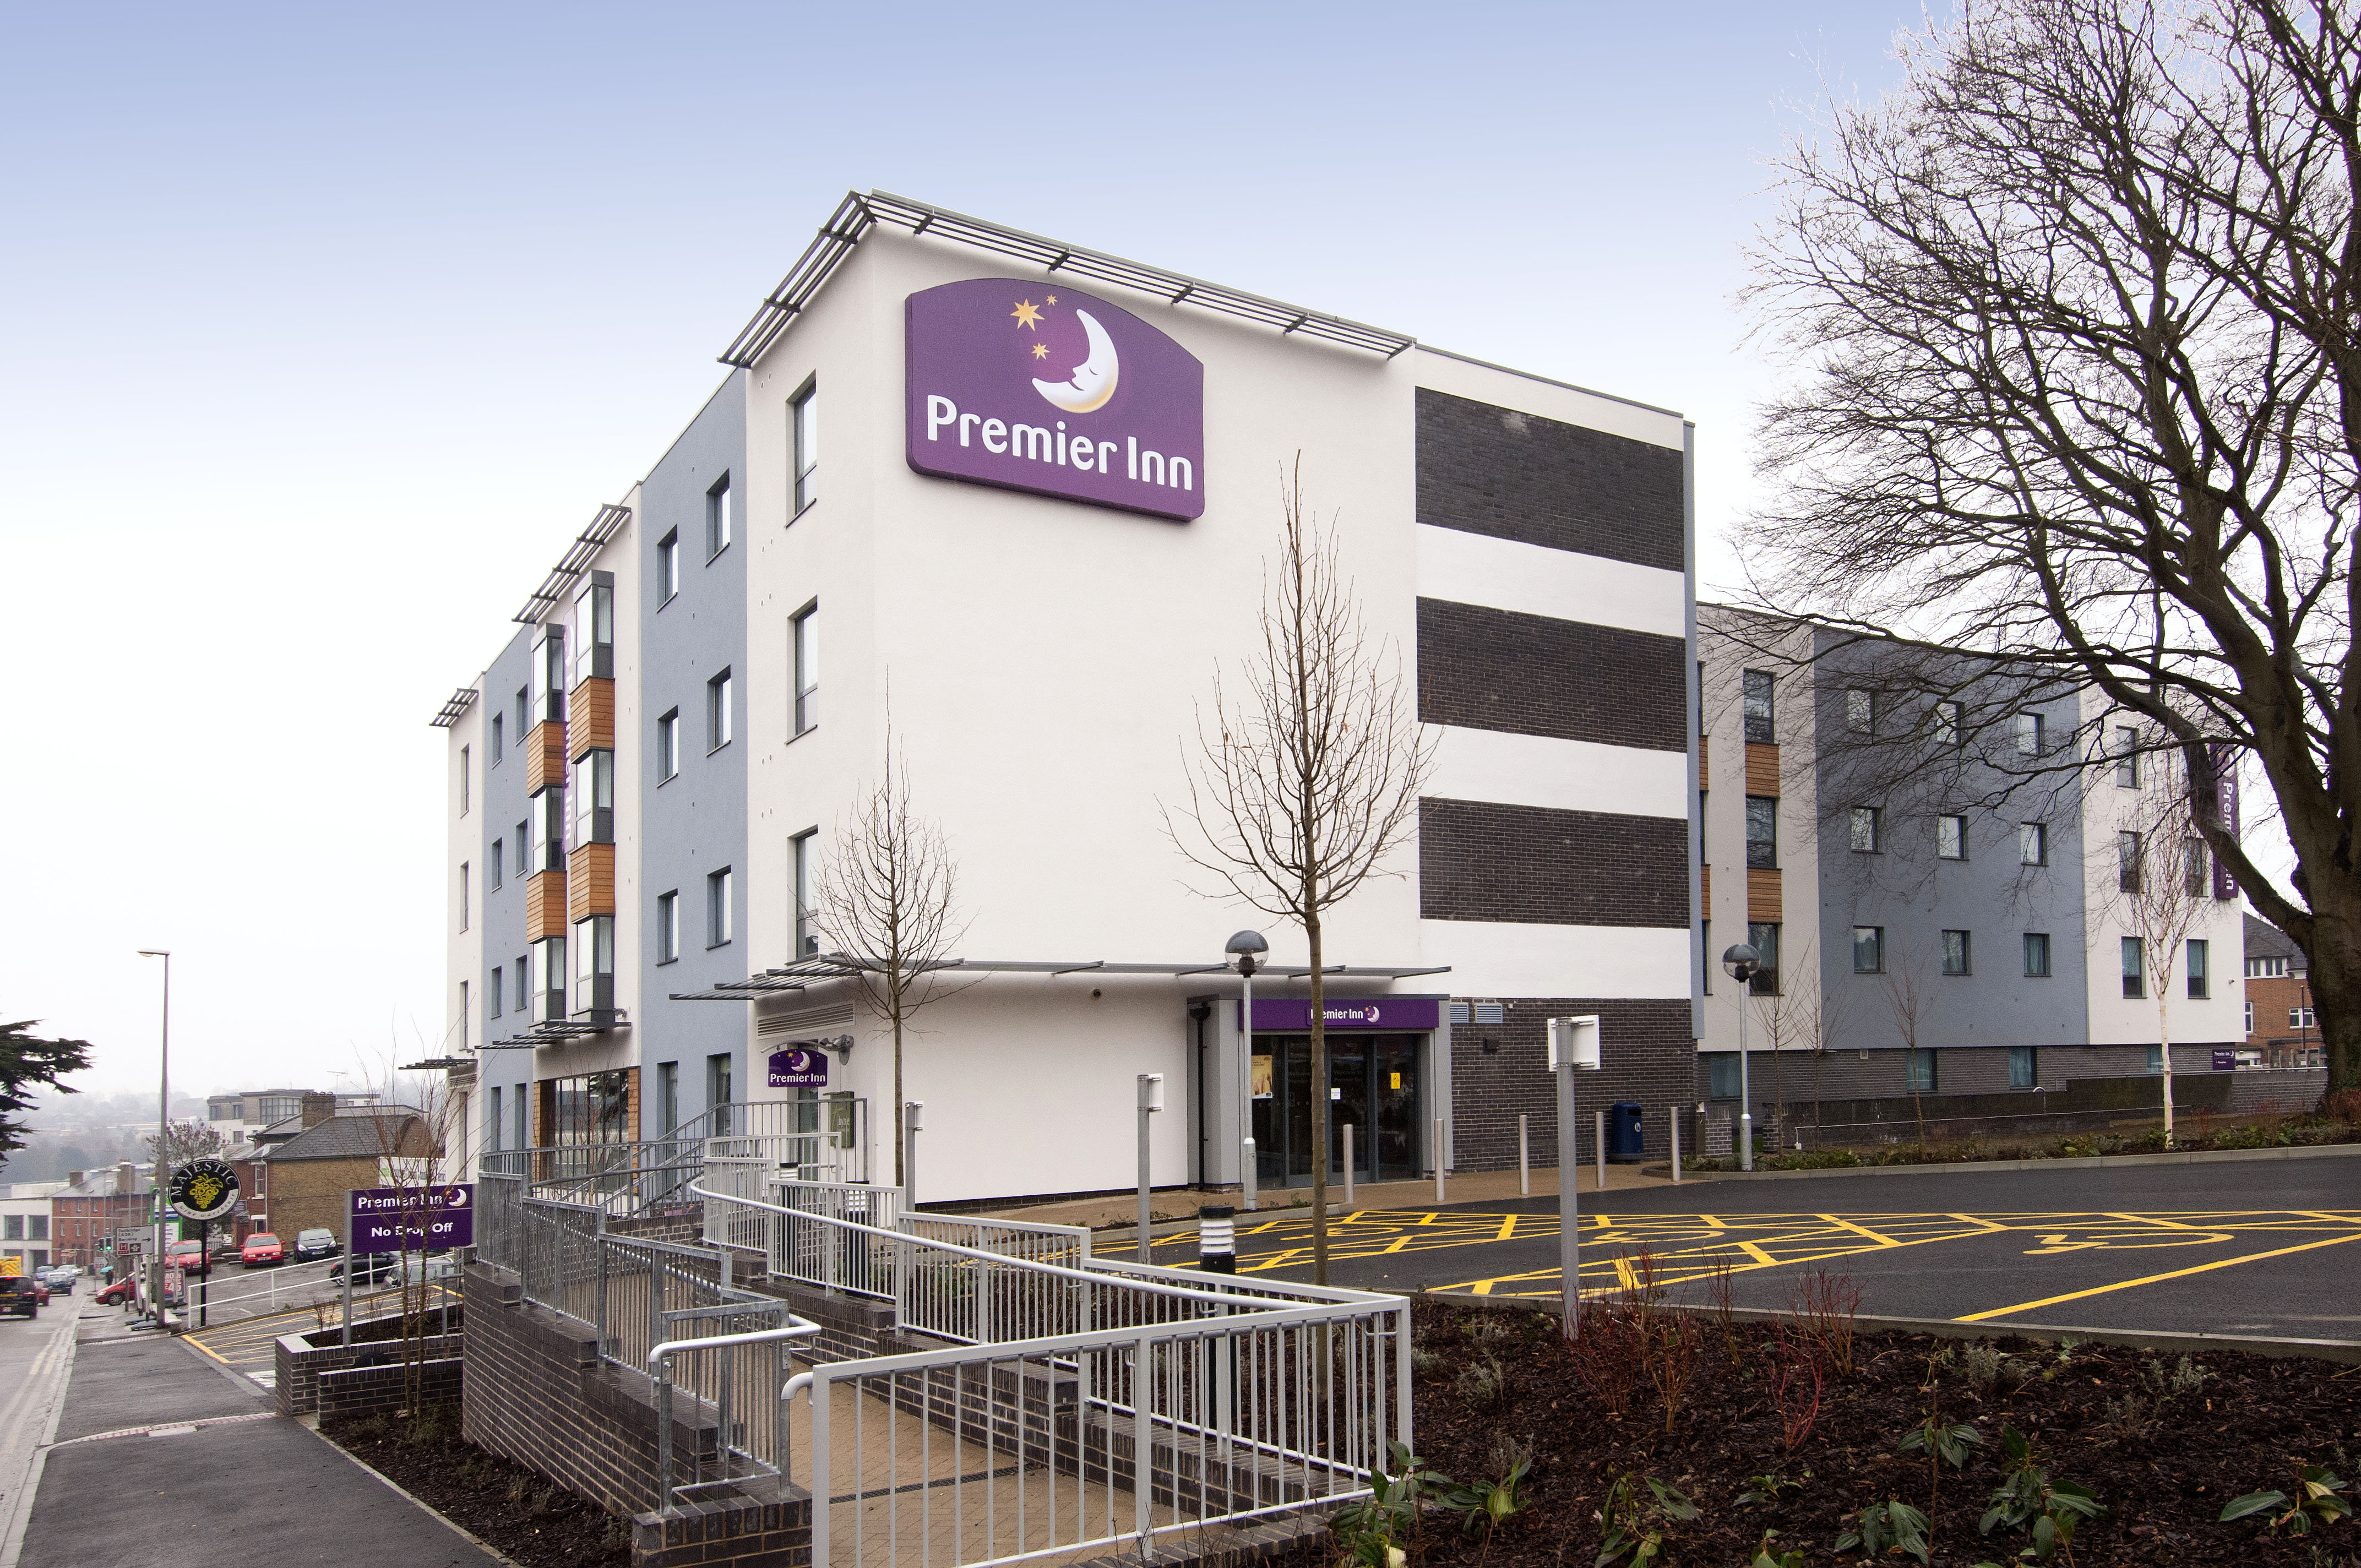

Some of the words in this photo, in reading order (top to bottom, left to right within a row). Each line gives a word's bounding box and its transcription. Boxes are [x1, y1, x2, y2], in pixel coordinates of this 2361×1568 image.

[927, 394, 1118, 474] Premier
[1128, 436, 1192, 491] Inn
[1349, 1009, 1363, 1019] Inn
[770, 1073, 809, 1082] Premier
[811, 1073, 825, 1082] Inn
[171, 1161, 237, 1196] MAJESTIC
[358, 1195, 416, 1208] Premier
[371, 1227, 391, 1237] No
[432, 1222, 453, 1233] Off
